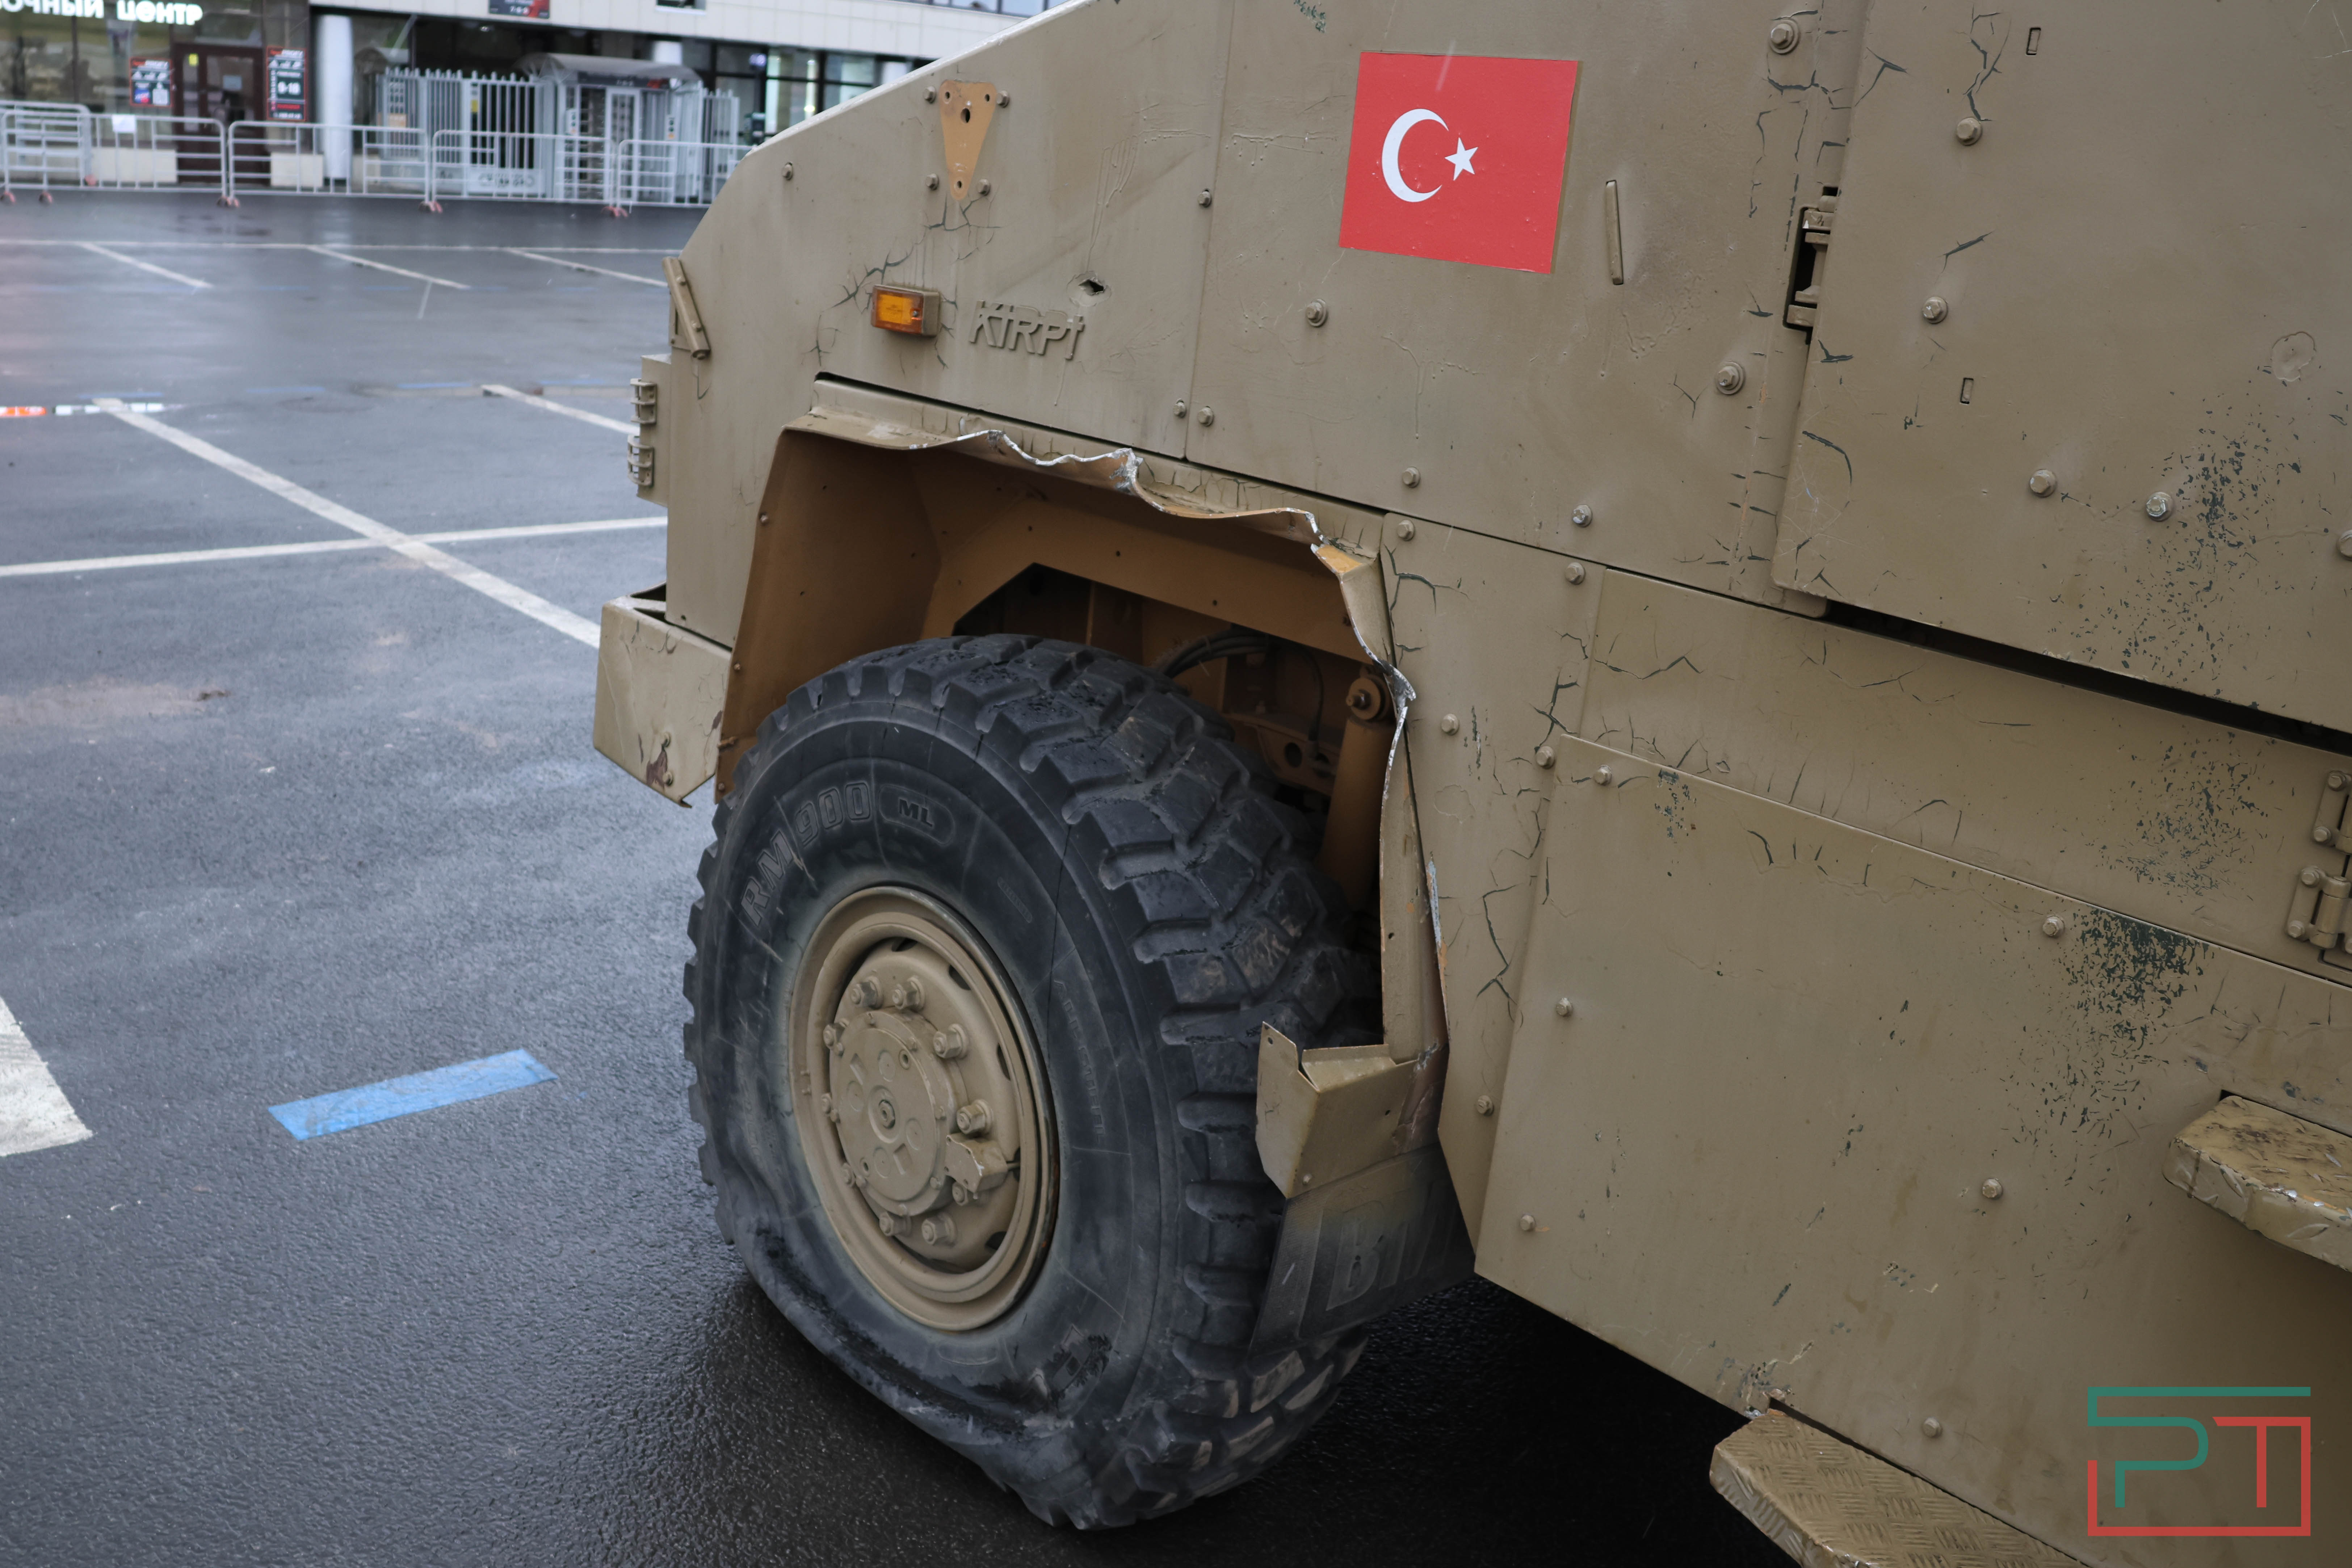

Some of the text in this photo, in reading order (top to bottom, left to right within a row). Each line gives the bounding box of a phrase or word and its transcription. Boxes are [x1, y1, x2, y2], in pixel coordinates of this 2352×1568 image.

[740, 781, 934, 927] RM 900 ML
